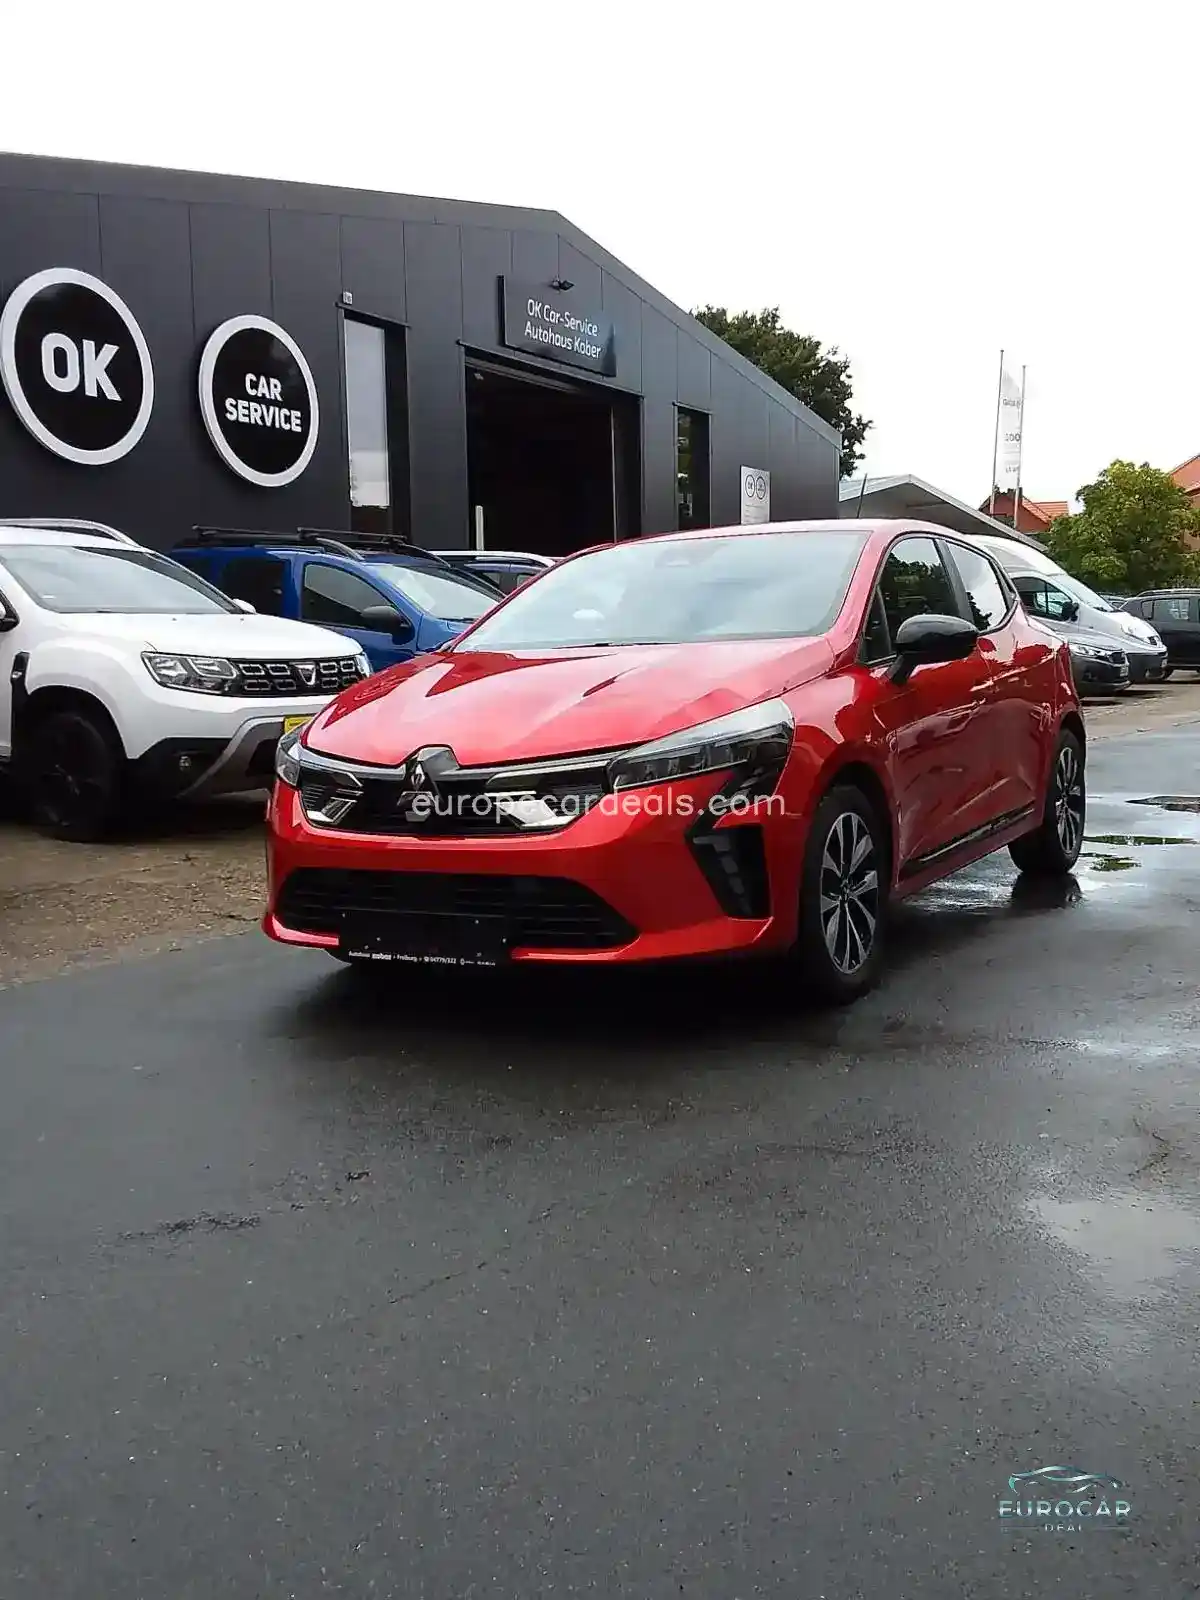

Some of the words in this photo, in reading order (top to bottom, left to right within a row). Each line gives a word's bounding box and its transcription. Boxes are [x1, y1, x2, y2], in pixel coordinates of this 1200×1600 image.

[527, 299, 542, 319] OK
[543, 304, 598, 337] Car-Service
[524, 320, 573, 350] Autohaus
[573, 336, 601, 359] Kober
[41, 332, 122, 401] OK
[245, 373, 283, 401] CAR
[225, 397, 302, 432] SERVICE
